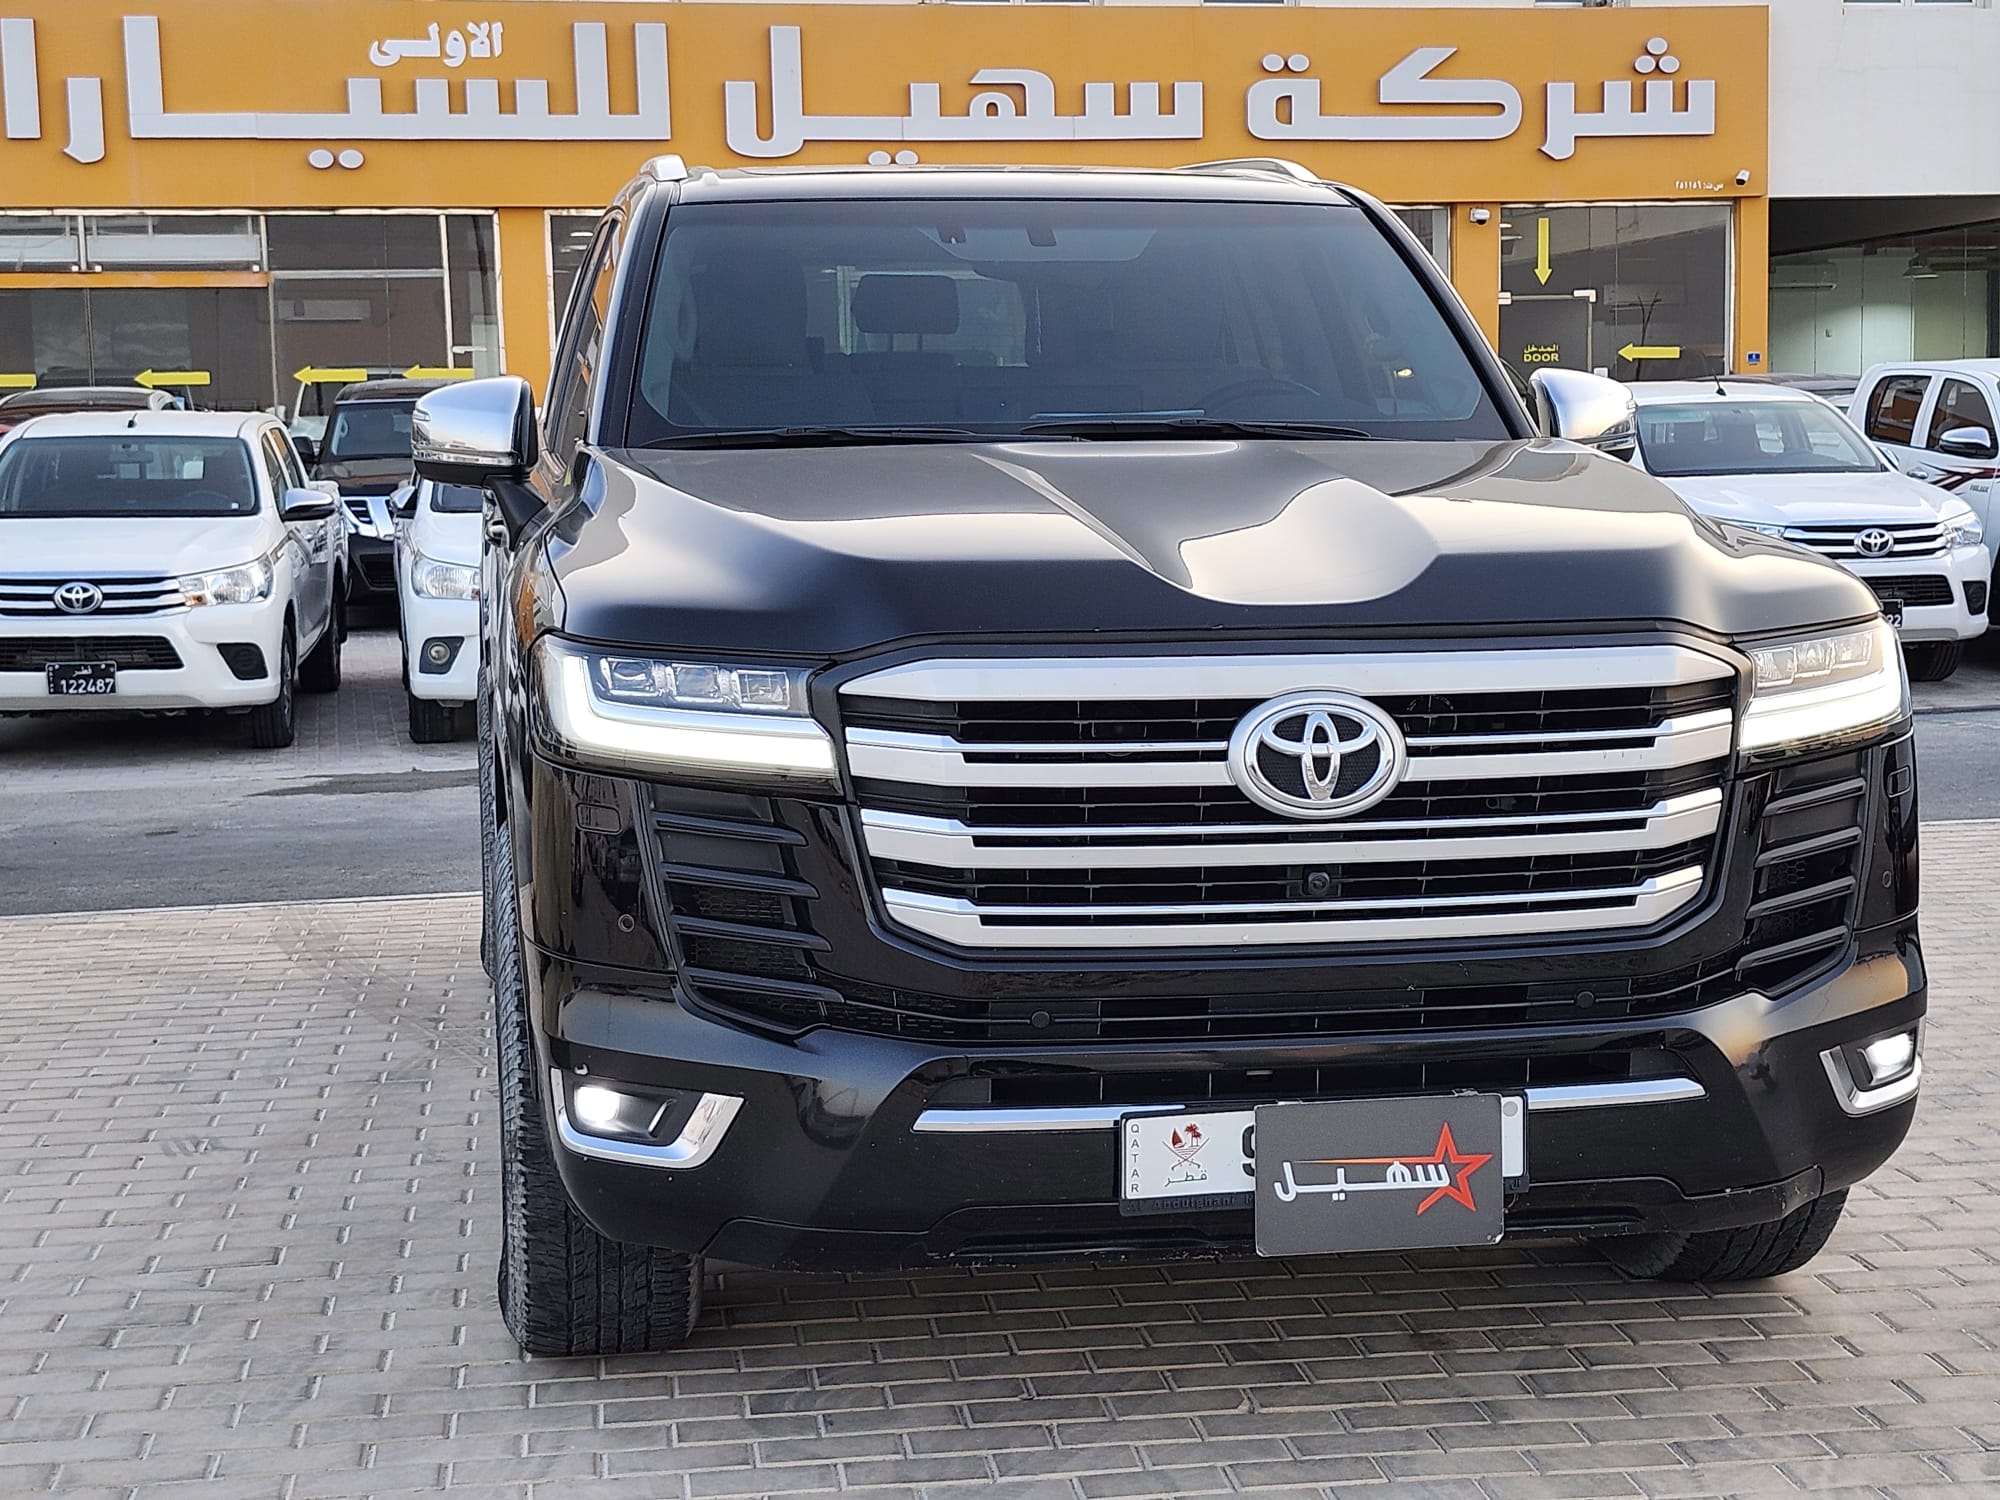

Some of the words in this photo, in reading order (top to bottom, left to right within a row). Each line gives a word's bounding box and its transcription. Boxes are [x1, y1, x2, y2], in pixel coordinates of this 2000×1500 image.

[725, 25, 1204, 165] سهيل
[1247, 36, 1716, 160] شركة
[1523, 353, 1559, 362] DOOR
[60, 678, 114, 694] 122487
[1130, 1123, 1140, 1193] QATAR
[1164, 1169, 1208, 1188] قطر
[1274, 1160, 1450, 1202] سهيل
